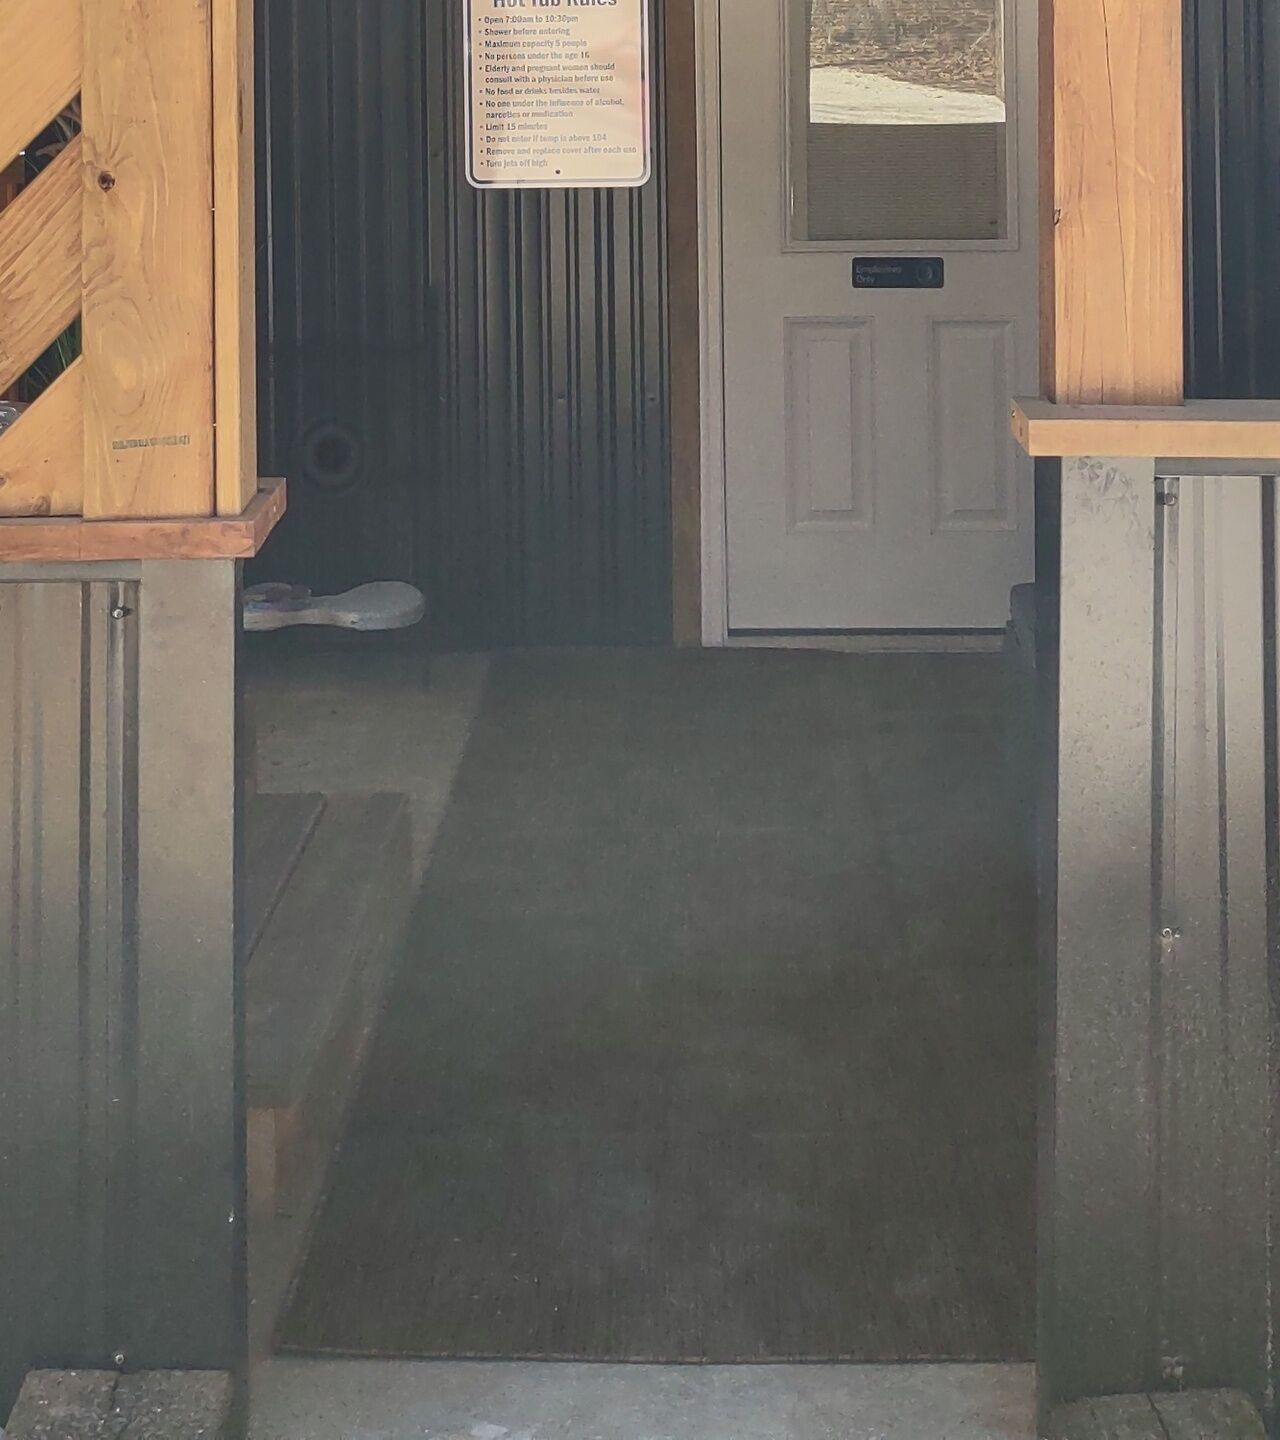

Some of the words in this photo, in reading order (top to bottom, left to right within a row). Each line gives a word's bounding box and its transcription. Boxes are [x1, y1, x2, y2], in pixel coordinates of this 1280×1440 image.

[484, 16, 504, 24] Open
[546, 15, 578, 23] 10:30pm
[539, 28, 570, 36] entering
[522, 40, 553, 48] capacity
[562, 40, 588, 48] people
[484, 64, 510, 73] Elderly
[527, 64, 560, 72] pregnant
[538, 76, 574, 84] physician
[540, 135, 559, 143] temp
[532, 147, 561, 155] replace
[603, 146, 622, 154] each
[504, 160, 518, 168] jets
[532, 160, 548, 168] high
